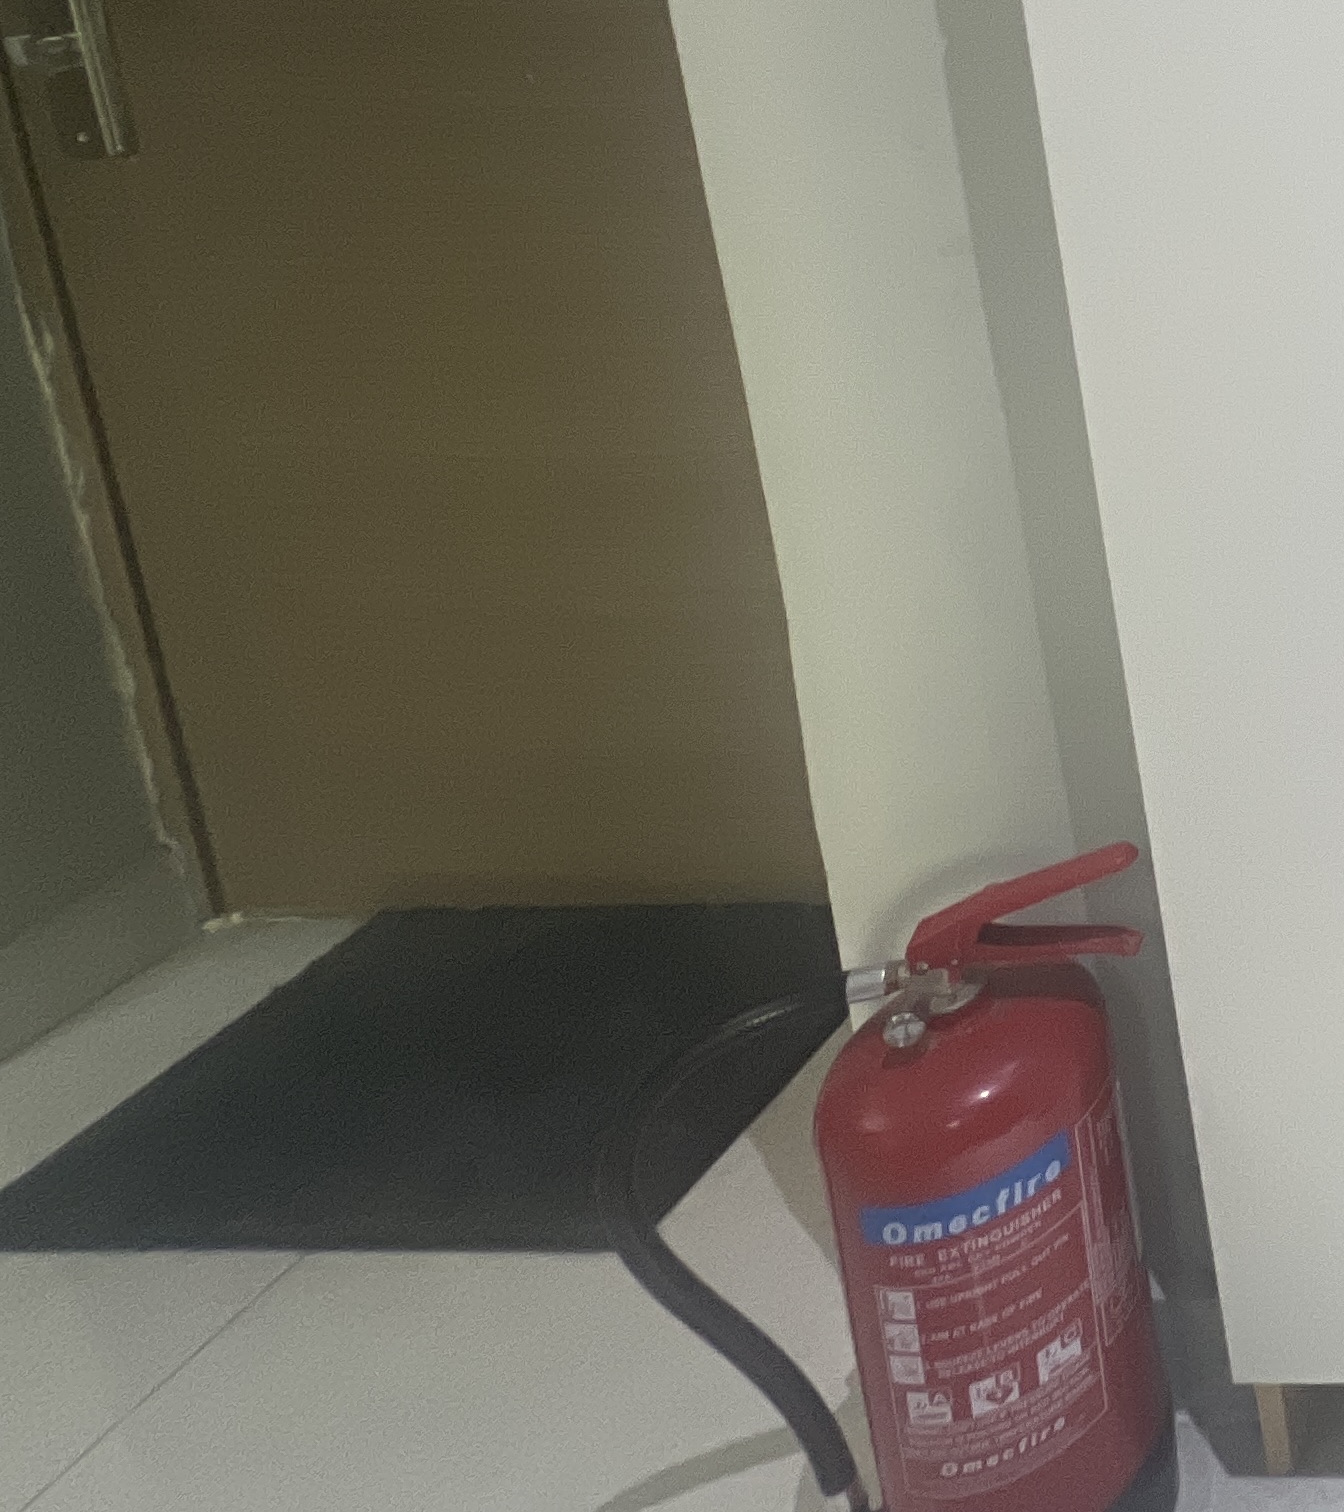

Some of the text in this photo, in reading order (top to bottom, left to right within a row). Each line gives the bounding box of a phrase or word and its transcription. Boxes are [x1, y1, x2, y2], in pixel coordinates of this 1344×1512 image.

[882, 1159, 1062, 1245] Omecfire
[889, 1252, 926, 1269] FIRE
[937, 1187, 1063, 1262] EXTINGUISHER
